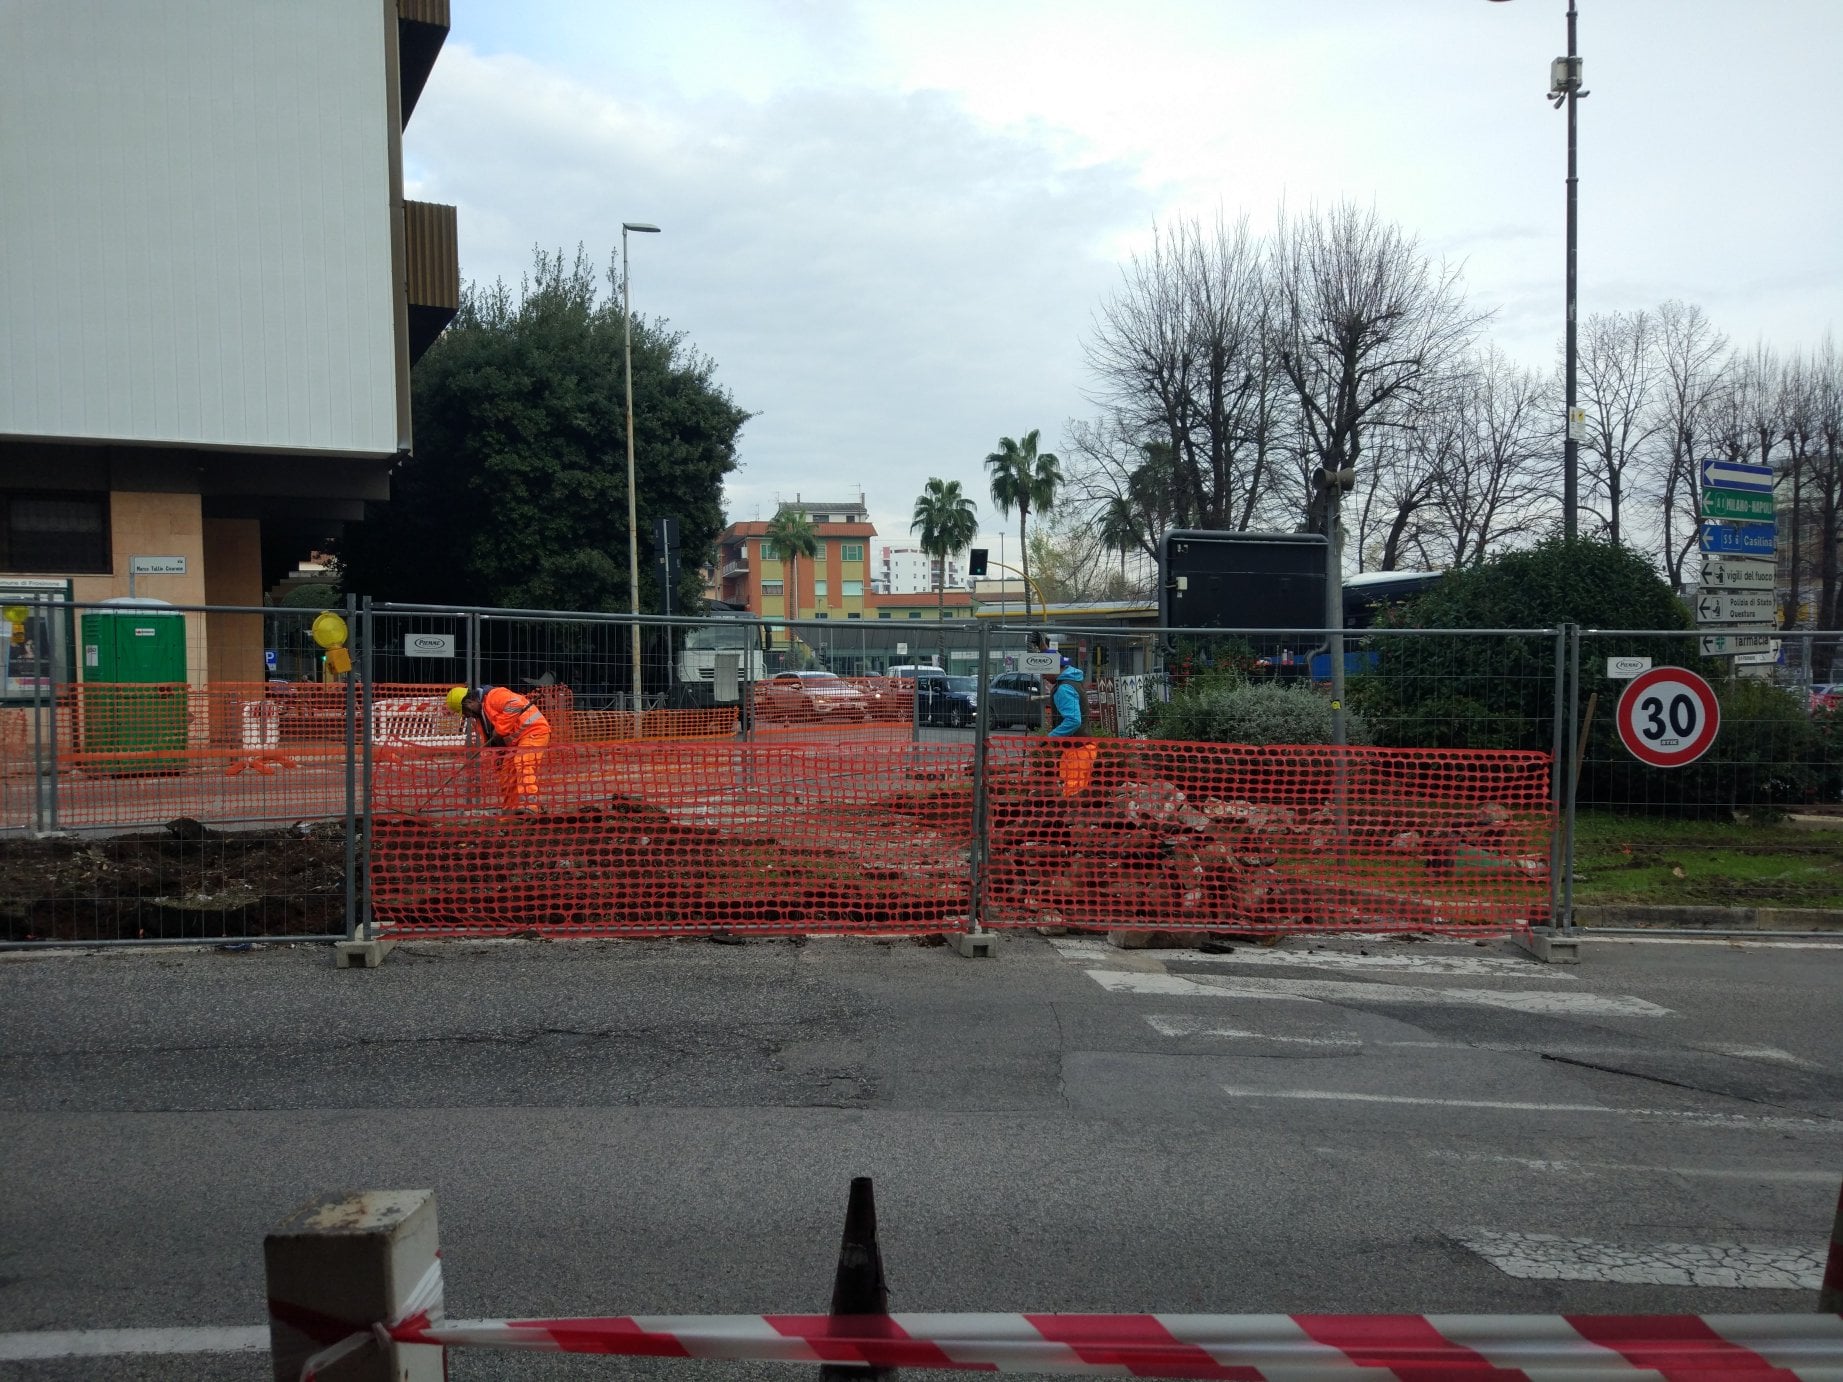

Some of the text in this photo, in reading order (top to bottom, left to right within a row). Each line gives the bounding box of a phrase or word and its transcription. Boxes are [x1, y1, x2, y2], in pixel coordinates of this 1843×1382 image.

[1743, 535, 1773, 547] Casilina
[1726, 569, 1773, 582] vigili del fuoco
[1729, 598, 1772, 606] Polizia di Stato
[1729, 610, 1756, 618] Questura
[1641, 693, 1696, 740] 30
